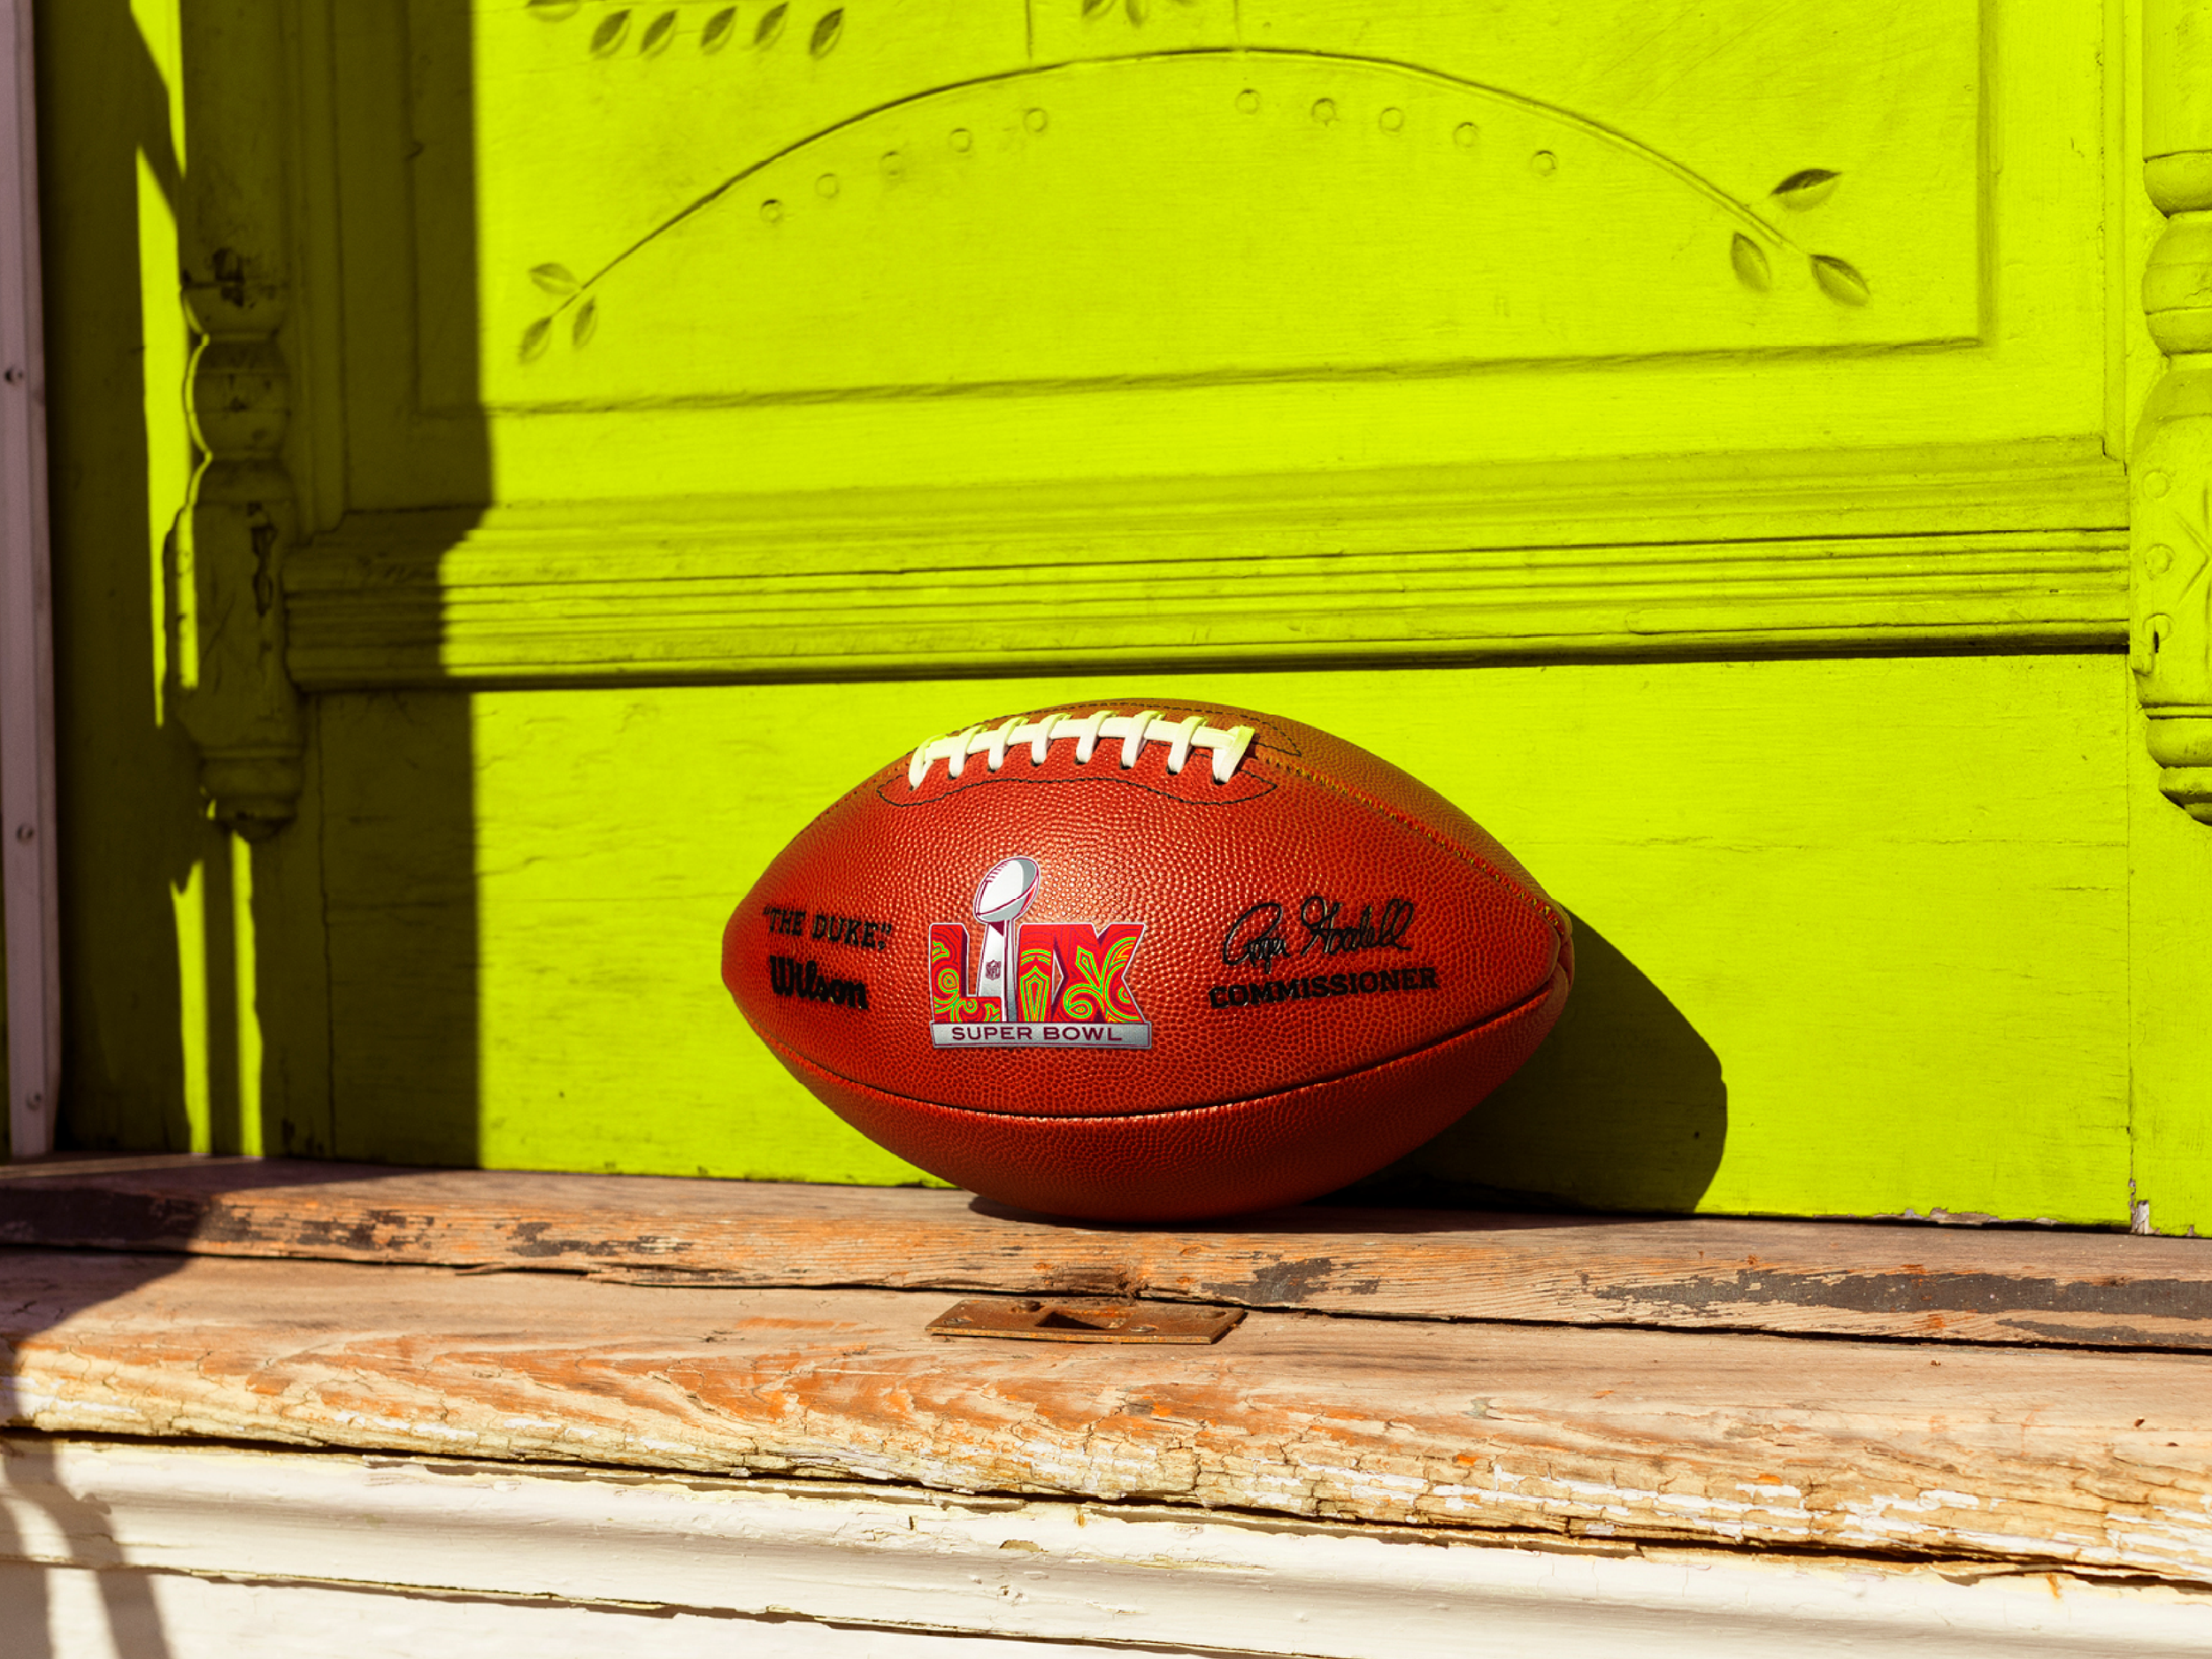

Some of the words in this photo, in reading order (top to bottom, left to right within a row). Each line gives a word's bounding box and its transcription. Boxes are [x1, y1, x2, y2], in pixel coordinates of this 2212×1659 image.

[769, 954, 869, 1010] Wilson
[1208, 966, 1439, 1009] COMMISSIONER
[951, 1026, 1033, 1041] SUPER
[1042, 1026, 1123, 1041] BOWL
